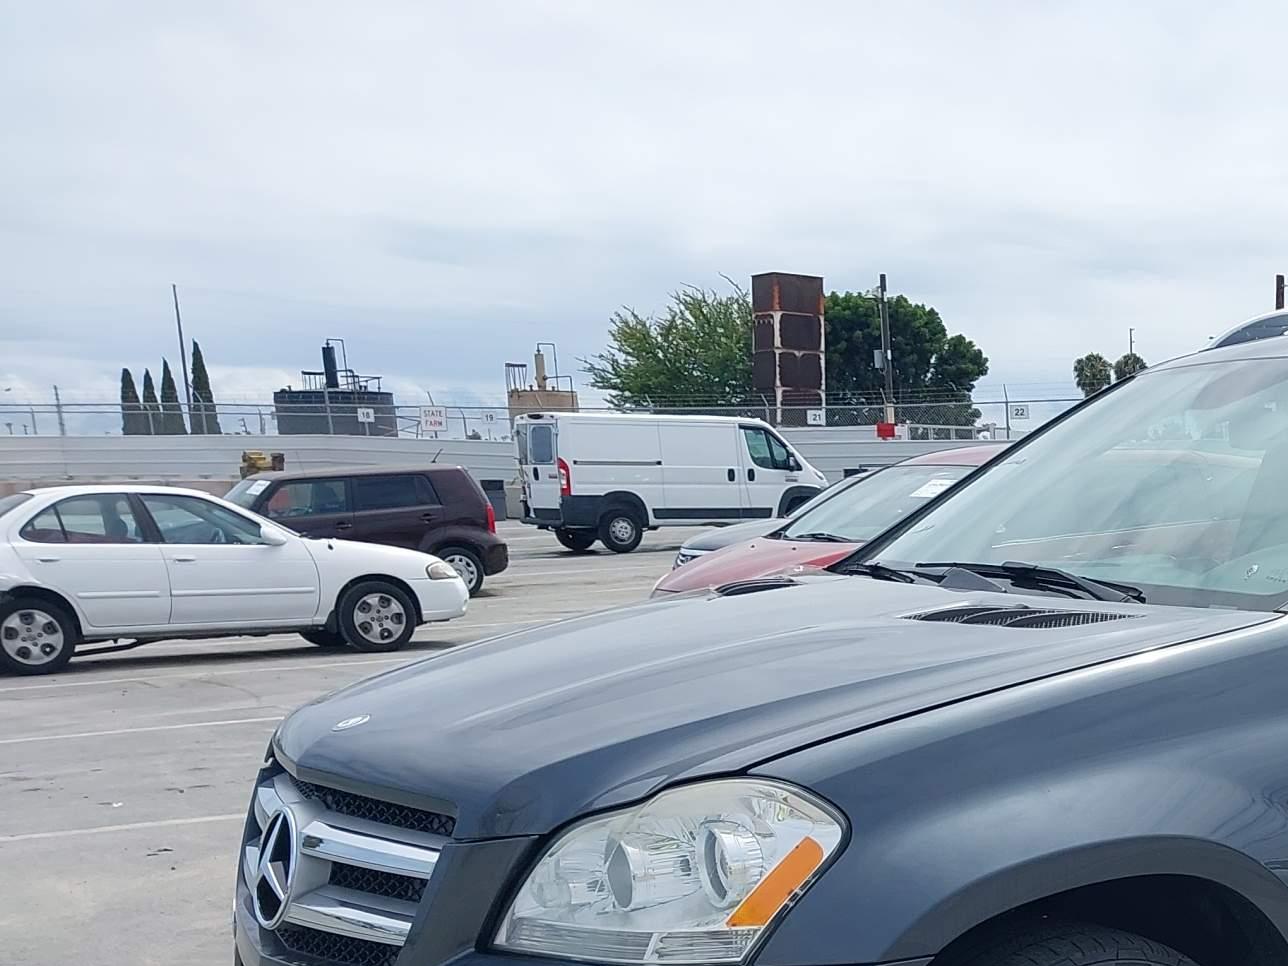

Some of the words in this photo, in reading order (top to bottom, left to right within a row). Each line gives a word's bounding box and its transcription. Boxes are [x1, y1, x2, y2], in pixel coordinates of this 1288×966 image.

[423, 409, 444, 418] STATE
[1014, 408, 1025, 417] 22
[485, 414, 494, 422] 19
[812, 413, 821, 421] 21
[425, 419, 443, 427] FARM
